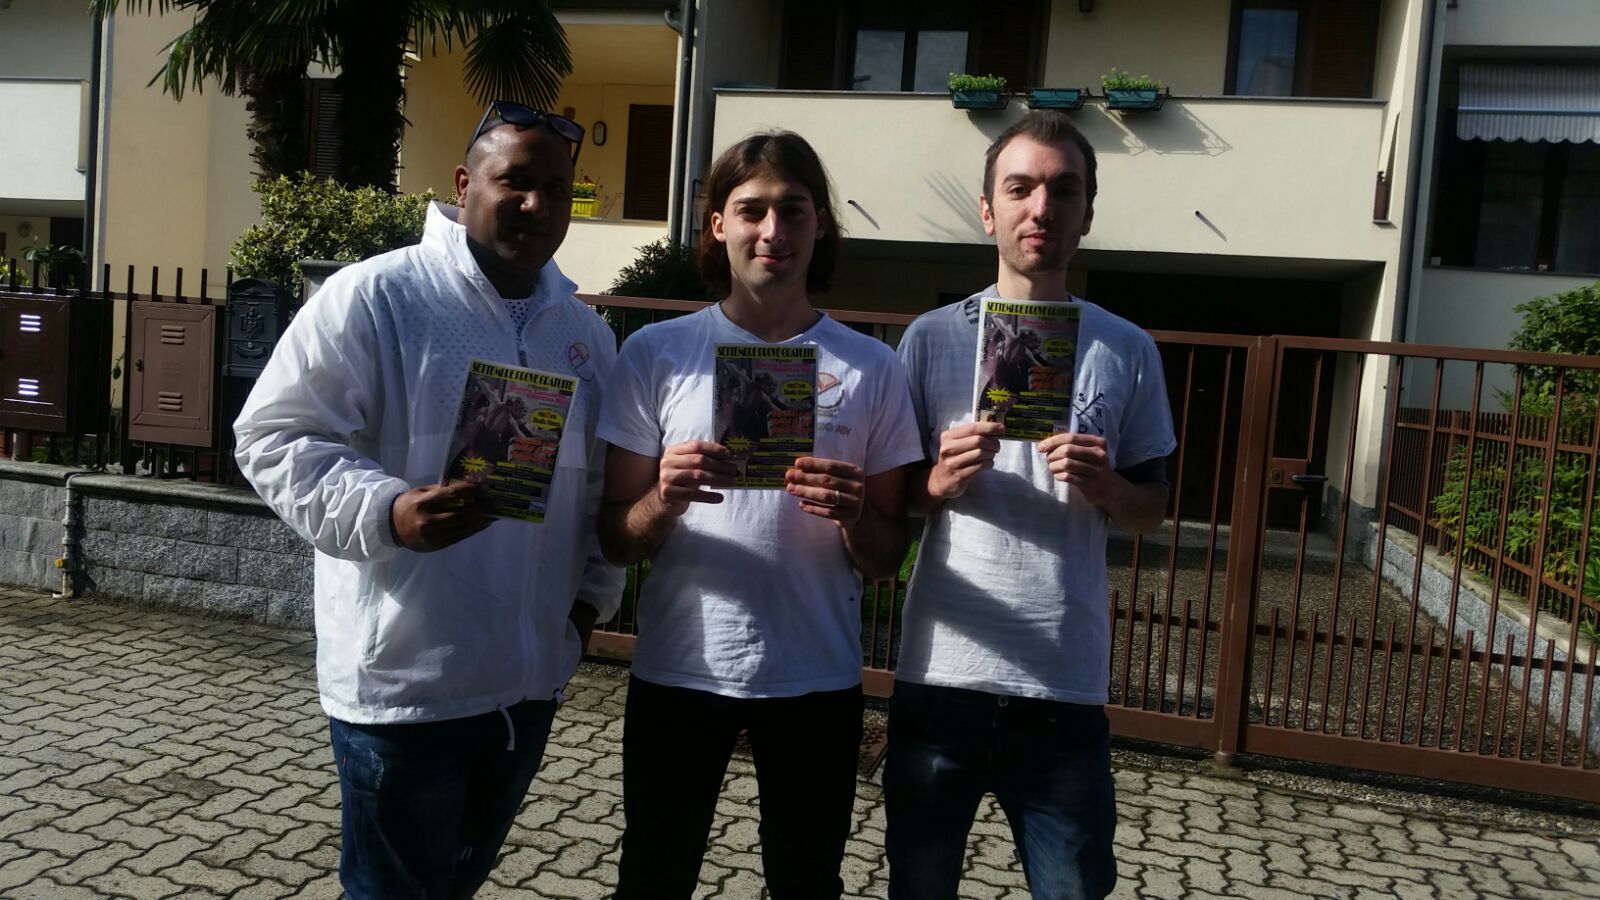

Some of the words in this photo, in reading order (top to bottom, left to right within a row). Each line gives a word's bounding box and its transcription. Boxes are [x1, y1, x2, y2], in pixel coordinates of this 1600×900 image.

[986, 301, 1025, 315] SETTEMBRE
[1025, 304, 1048, 316] PROVE
[717, 346, 759, 357] SETTEMBRE
[760, 347, 781, 357] PROVE
[781, 347, 815, 358] GRATUITE
[472, 361, 514, 379] SETTEMBRE
[514, 368, 540, 383] PROVE
[539, 373, 573, 391] GRATUITE
